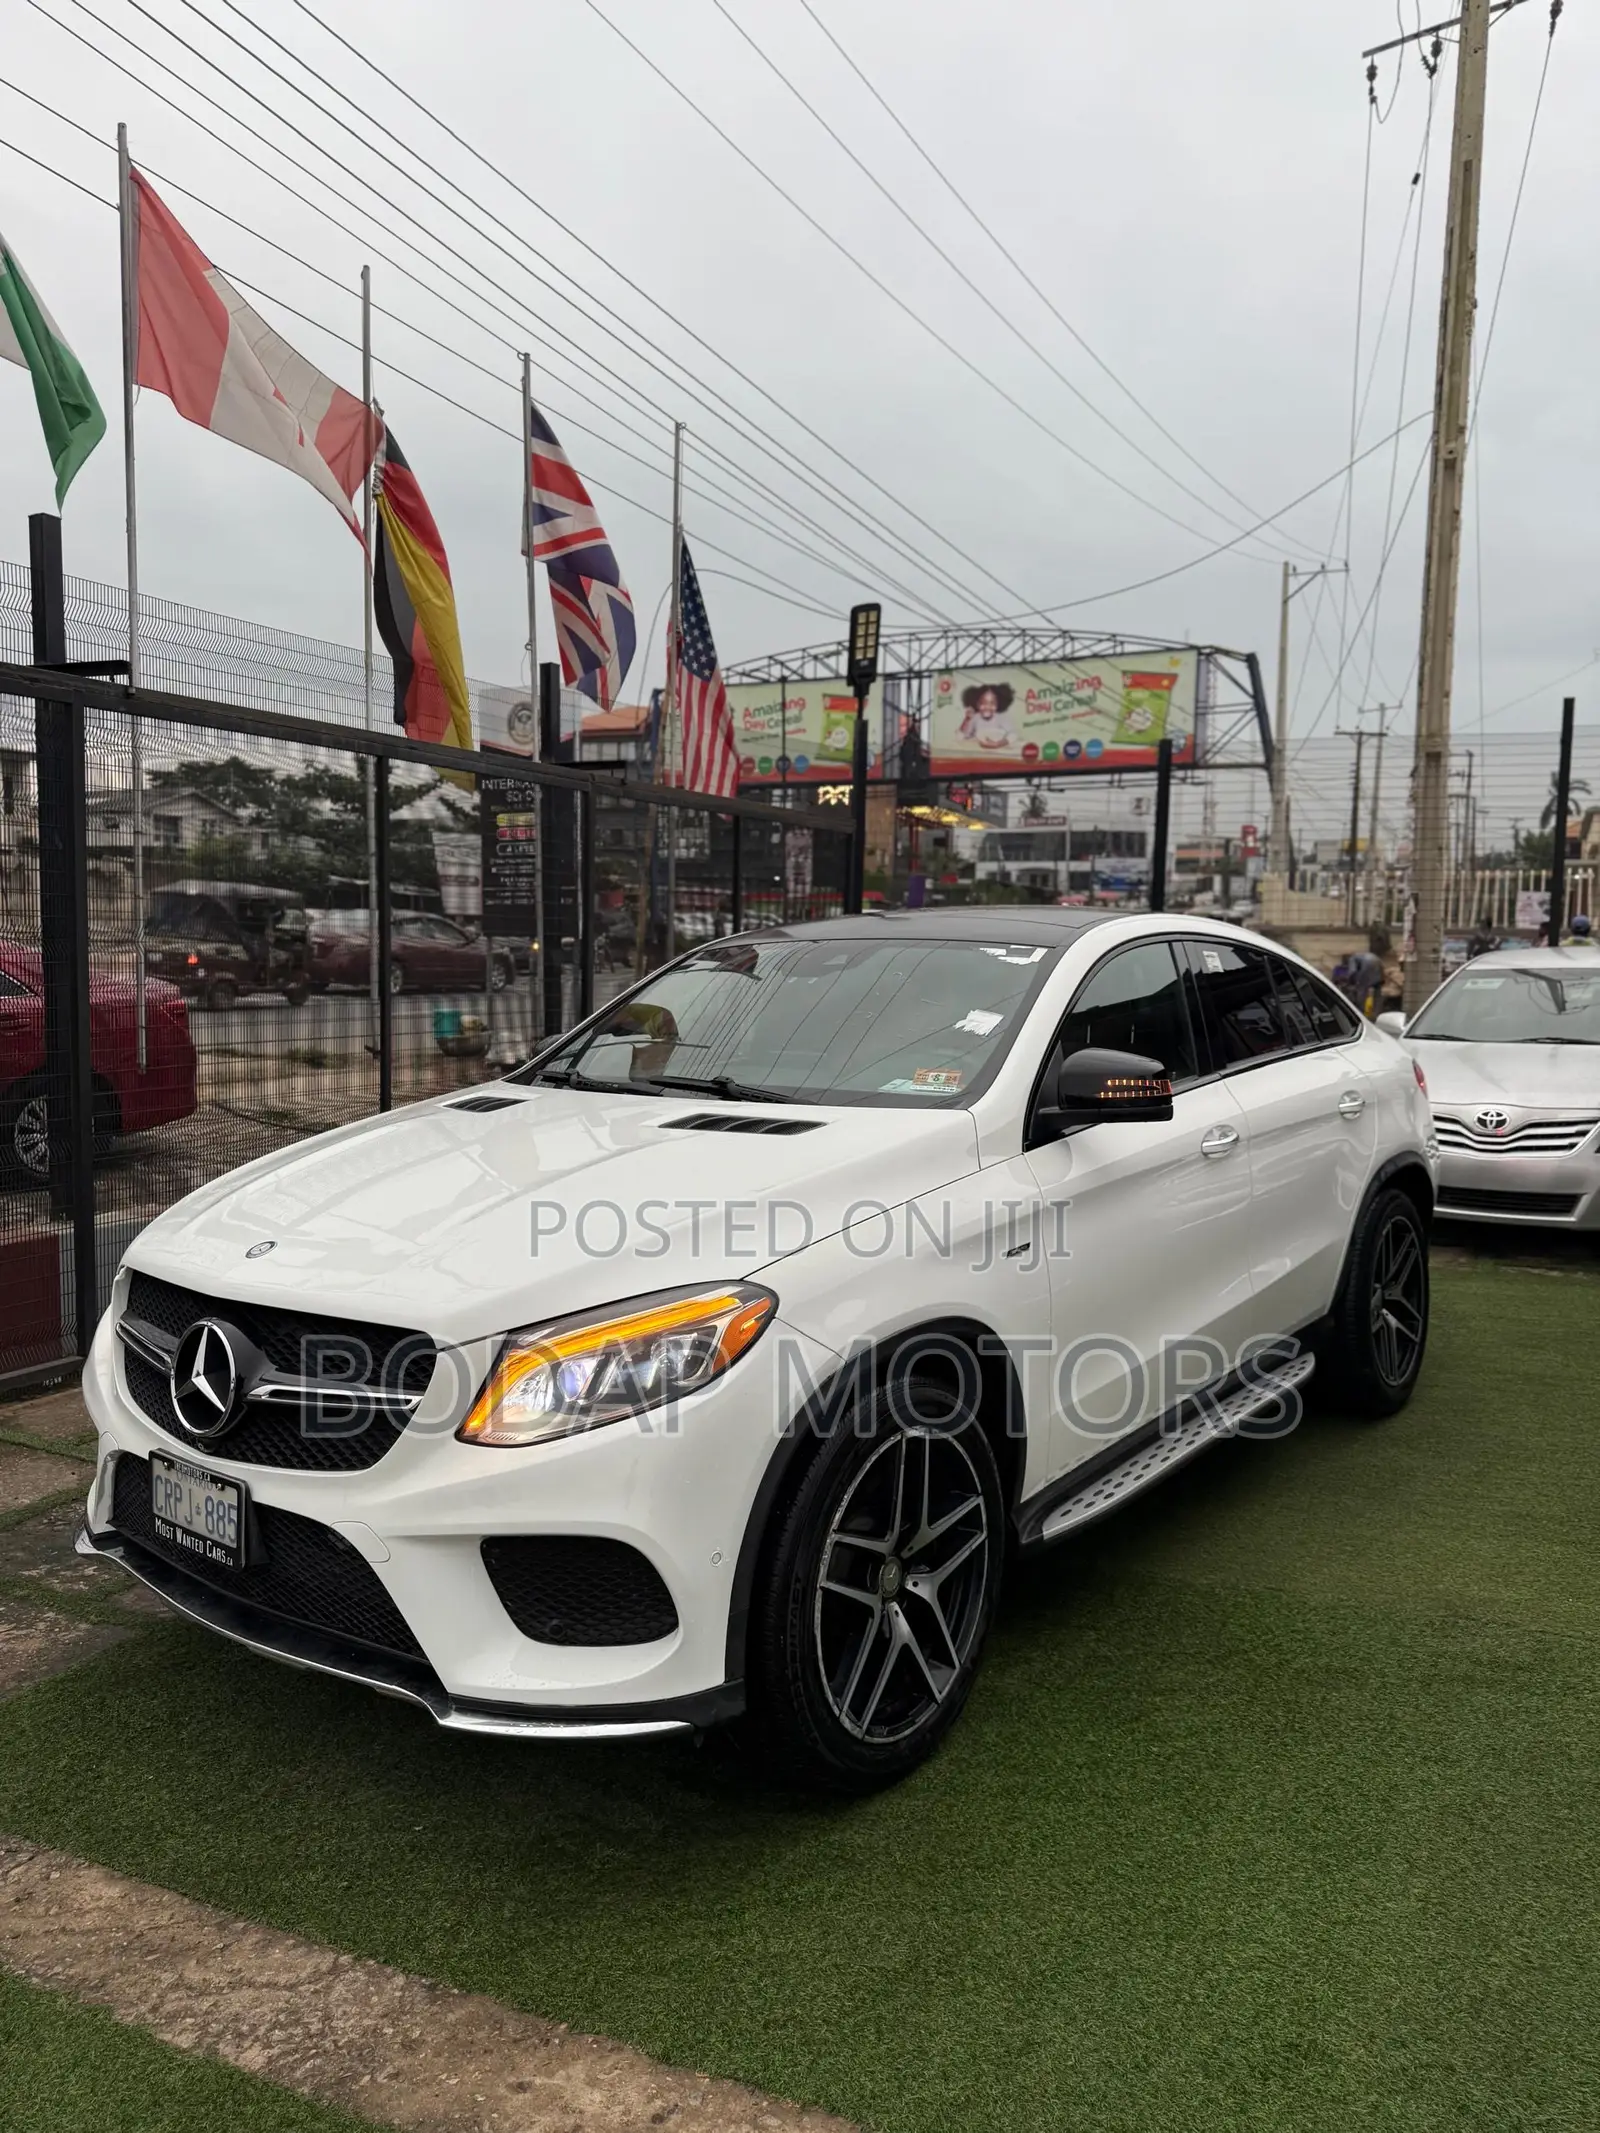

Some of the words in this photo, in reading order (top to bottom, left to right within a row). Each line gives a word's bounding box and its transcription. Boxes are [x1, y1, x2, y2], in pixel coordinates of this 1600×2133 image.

[766, 710, 803, 729] Ceeal
[155, 1475, 193, 1525] CRPJ
[205, 1495, 237, 1544] 885
